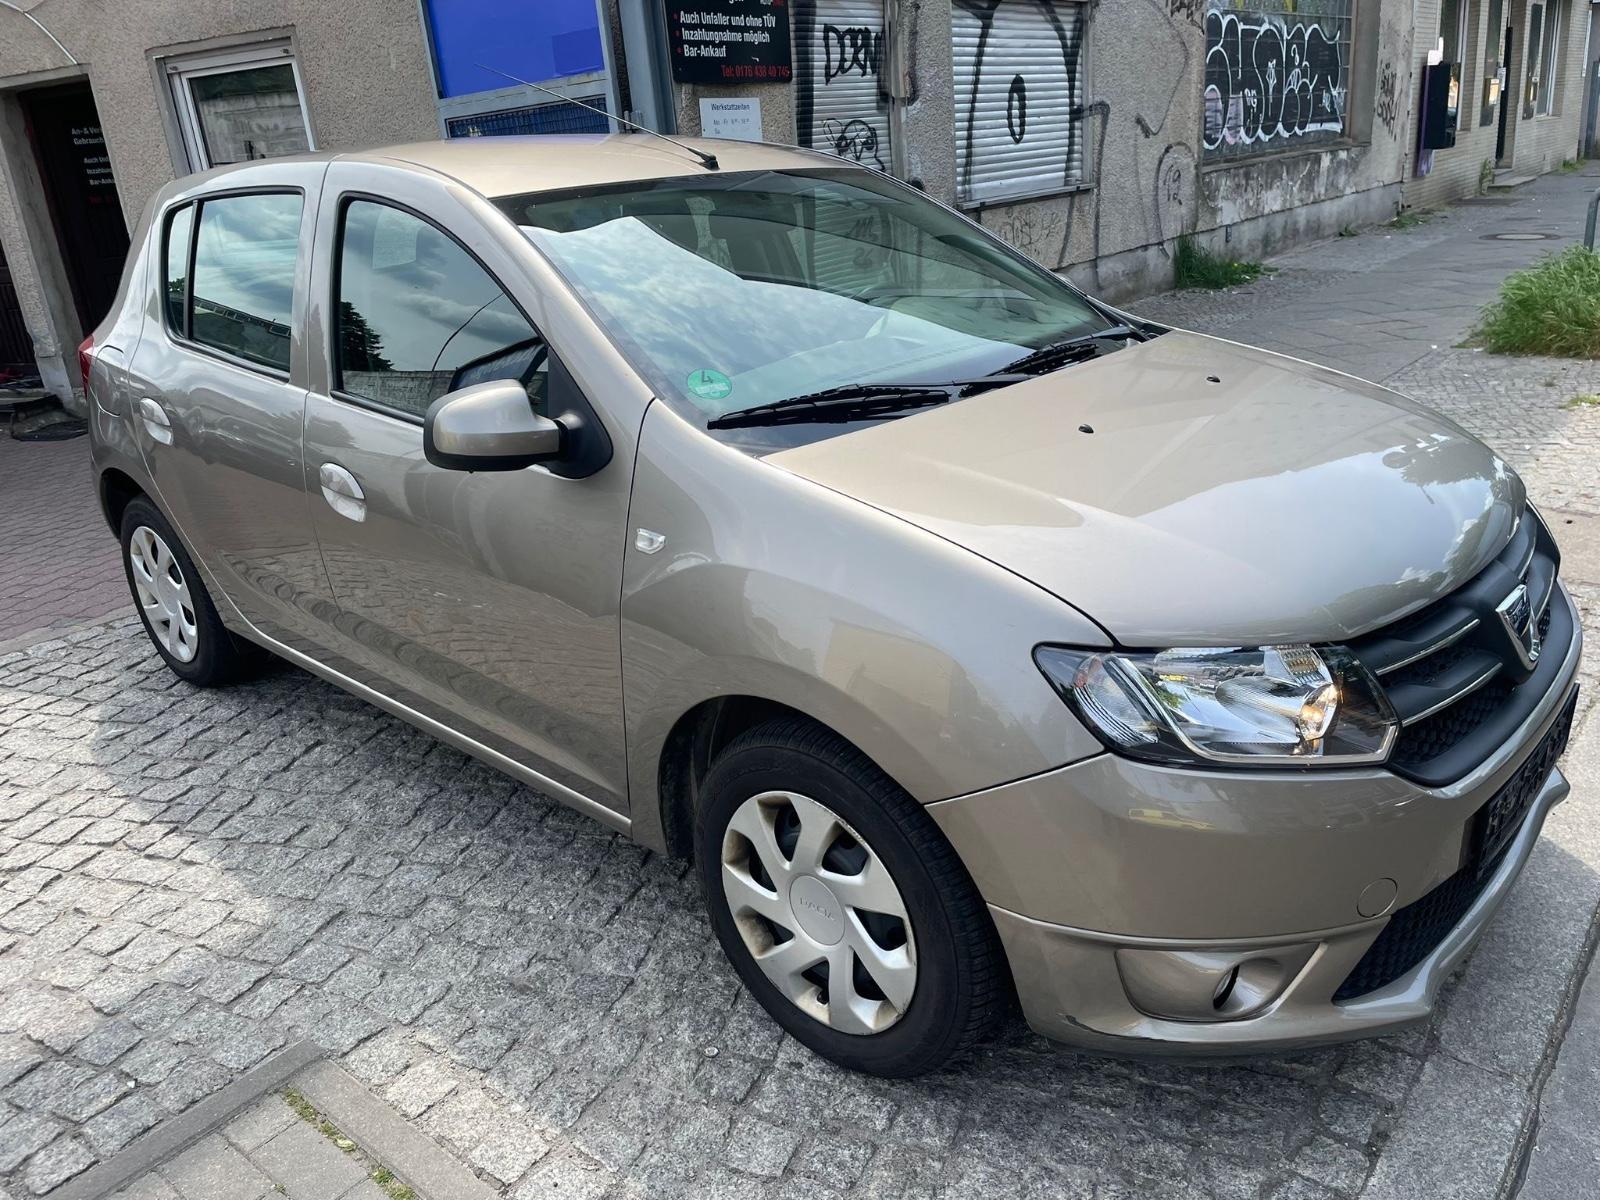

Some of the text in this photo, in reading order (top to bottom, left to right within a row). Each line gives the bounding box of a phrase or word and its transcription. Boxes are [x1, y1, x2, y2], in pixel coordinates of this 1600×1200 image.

[680, 10, 699, 24] Auch
[731, 14, 745, 26] und
[746, 15, 763, 27] ohne
[763, 13, 776, 27] TÜV
[681, 27, 770, 45] Inzahlungnahme möglich
[683, 44, 727, 57] Bar-Ankauf
